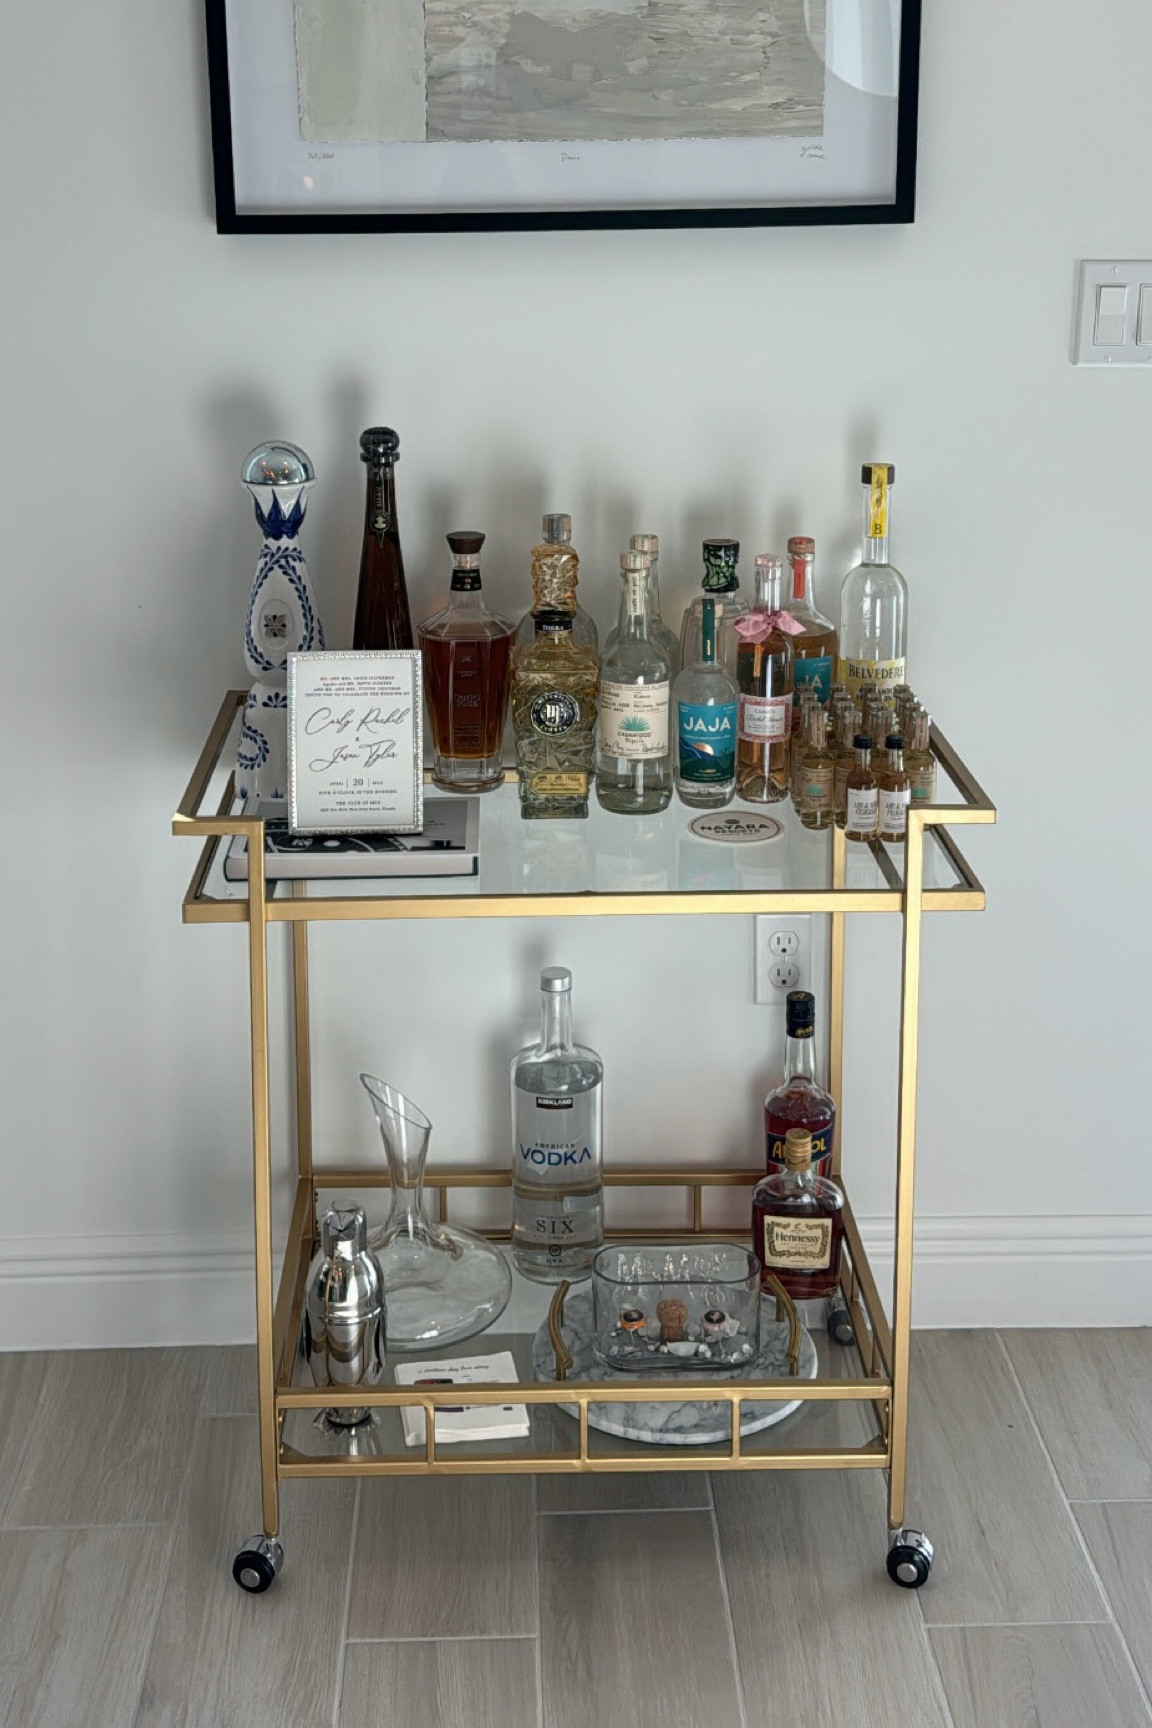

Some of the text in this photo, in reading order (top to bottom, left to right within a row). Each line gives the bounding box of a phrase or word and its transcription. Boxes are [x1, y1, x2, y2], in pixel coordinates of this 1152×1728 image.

[874, 523, 882, 534] B
[848, 664, 903, 679] BELVEDERE
[305, 706, 354, 734] Carly
[683, 716, 731, 732] JAJA
[352, 777, 364, 787] 20
[700, 823, 770, 831] NAYARA
[537, 1098, 573, 1107] KIRKLAND
[520, 1143, 592, 1166] VODKA
[536, 1219, 574, 1234] SIX
[775, 1231, 821, 1245] Hennessy
